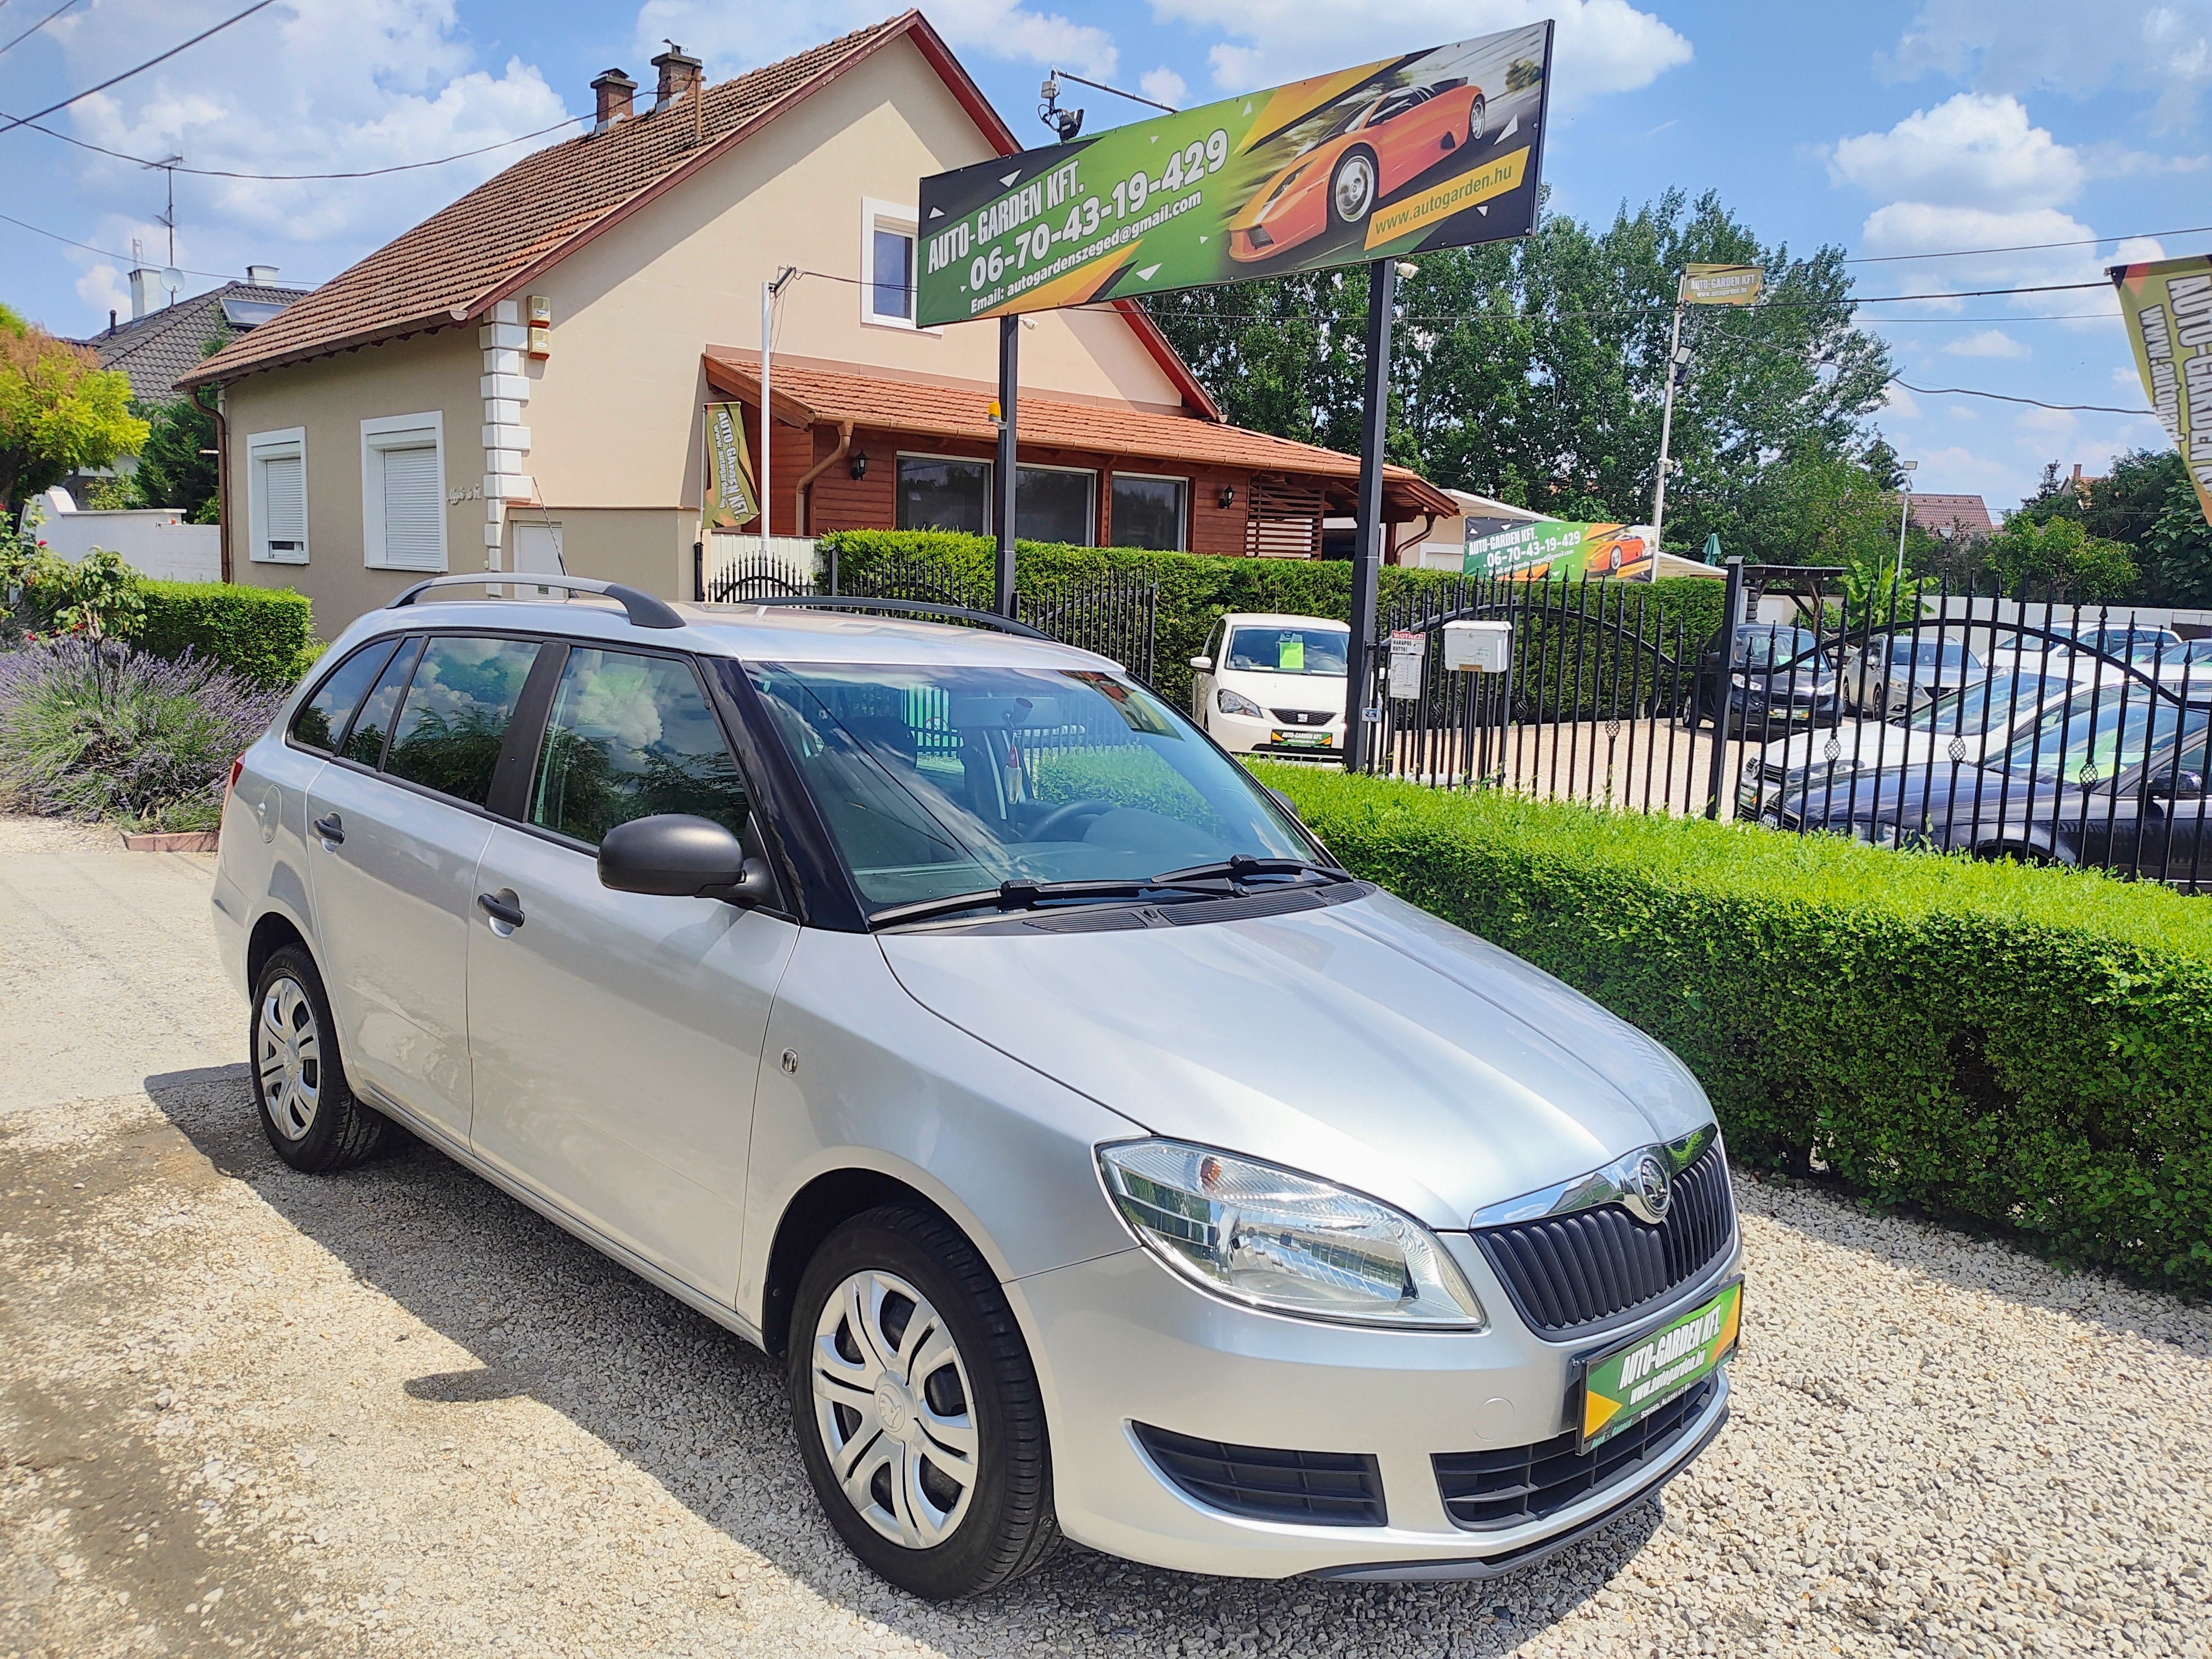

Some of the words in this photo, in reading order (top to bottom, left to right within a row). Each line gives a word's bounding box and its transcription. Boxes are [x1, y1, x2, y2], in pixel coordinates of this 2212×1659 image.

[927, 179, 1042, 274] AUTO-GARDEN
[1046, 160, 1085, 210] KFT.
[969, 128, 1229, 291] 06-70-43-19-429
[1375, 165, 1512, 235] www.autogarden.hu
[970, 287, 1005, 314] Email:
[1007, 190, 1201, 296] autogardenszeged@gmail.com
[1690, 275, 1740, 290] AUTO-GARDEN
[1741, 274, 1757, 285] KFT.
[717, 411, 742, 495] AUTO-GARDEN
[727, 493, 750, 521] KFT.
[1469, 530, 1522, 556] AUTO-GARDEN
[1521, 527, 1538, 543] KFT.
[1487, 530, 1581, 567] 06-70-43-19-429
[1488, 566, 1503, 576] Eail:
[1618, 1317, 1703, 1391] AUTO-GARDEN
[1701, 1304, 1721, 1344] KFT.
[1629, 1348, 1707, 1406] www.autogarden.hu
